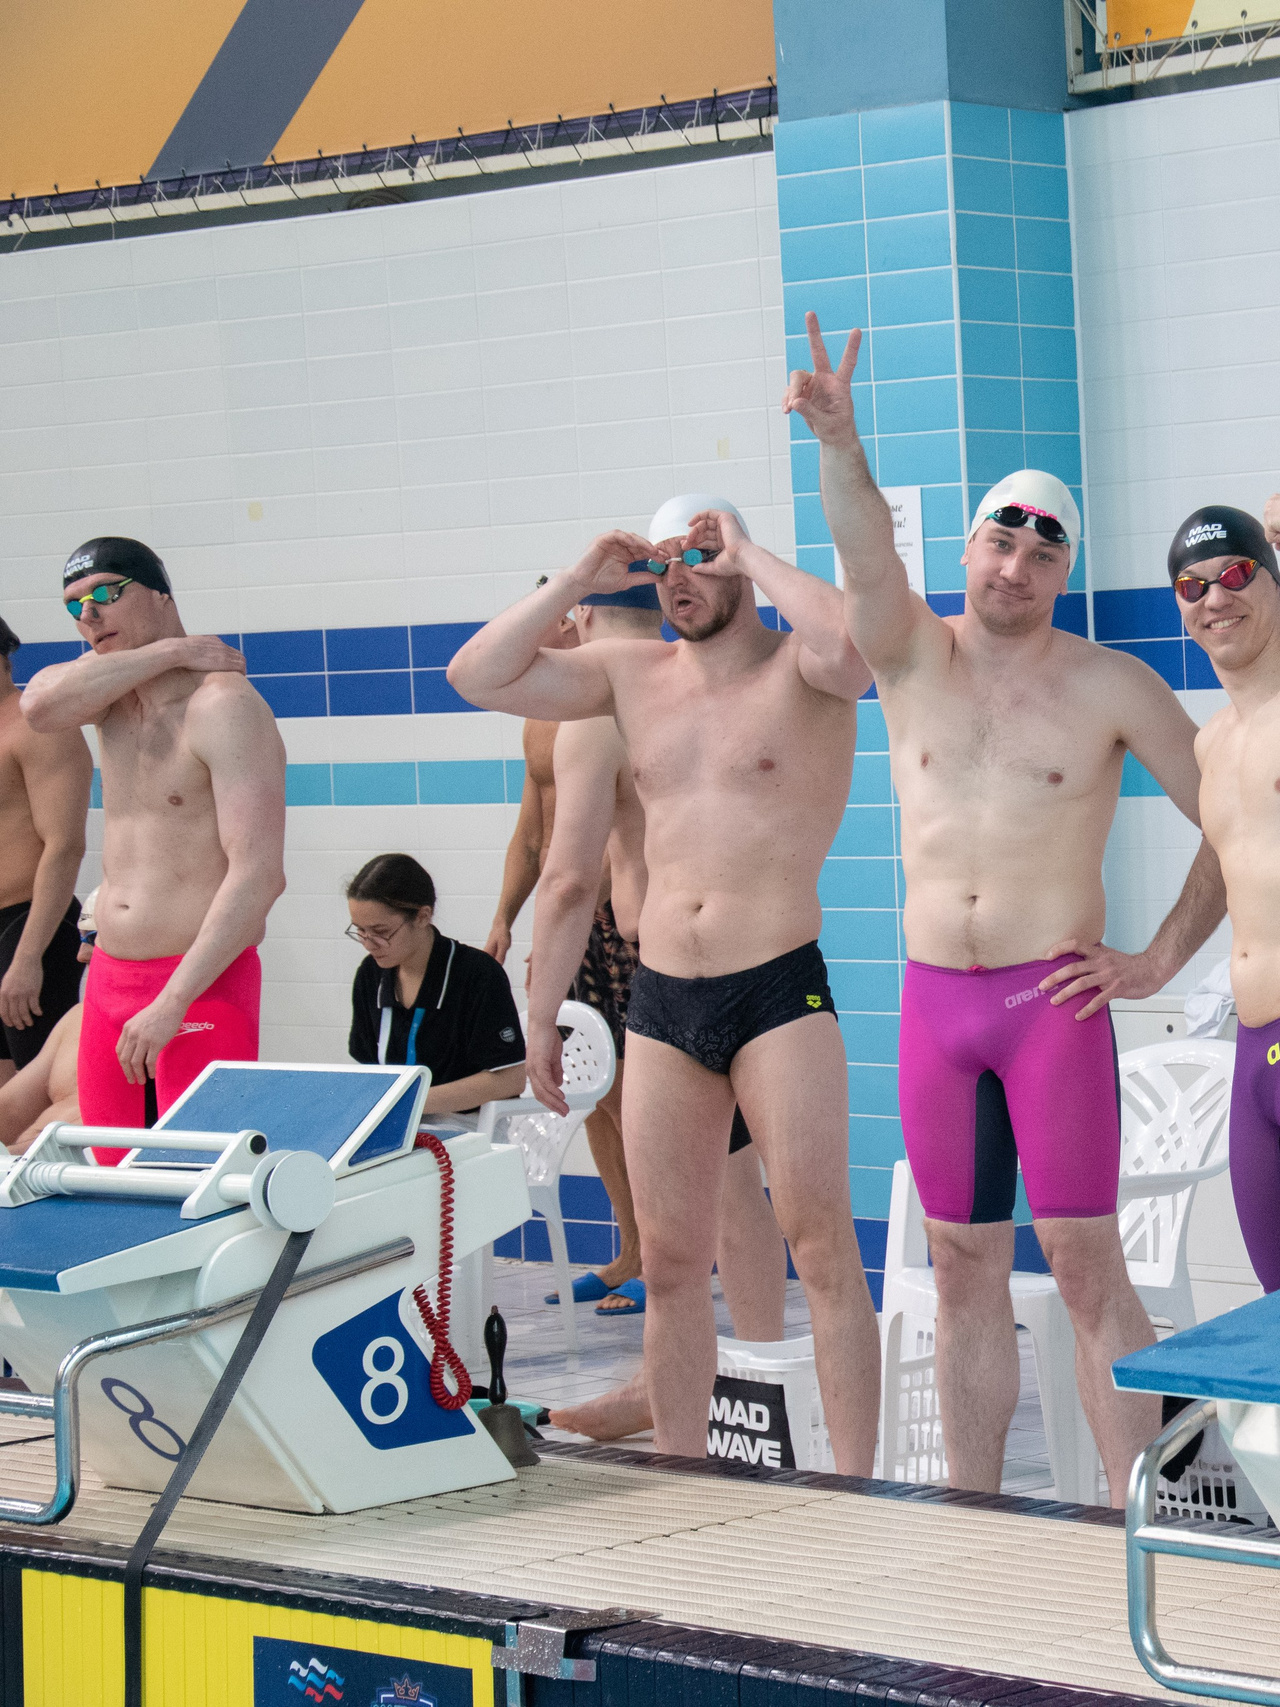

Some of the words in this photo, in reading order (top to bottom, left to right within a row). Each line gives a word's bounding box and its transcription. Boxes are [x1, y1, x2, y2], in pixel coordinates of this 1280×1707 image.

[1185, 530, 1227, 548] WAVE
[1189, 523, 1222, 537] MAD
[64, 560, 94, 578] WAVE
[66, 554, 90, 570] MAD
[361, 1336, 409, 1425] 8
[101, 1377, 188, 1463] 8
[708, 1395, 770, 1432] MAD
[707, 1428, 781, 1468] WAVE
